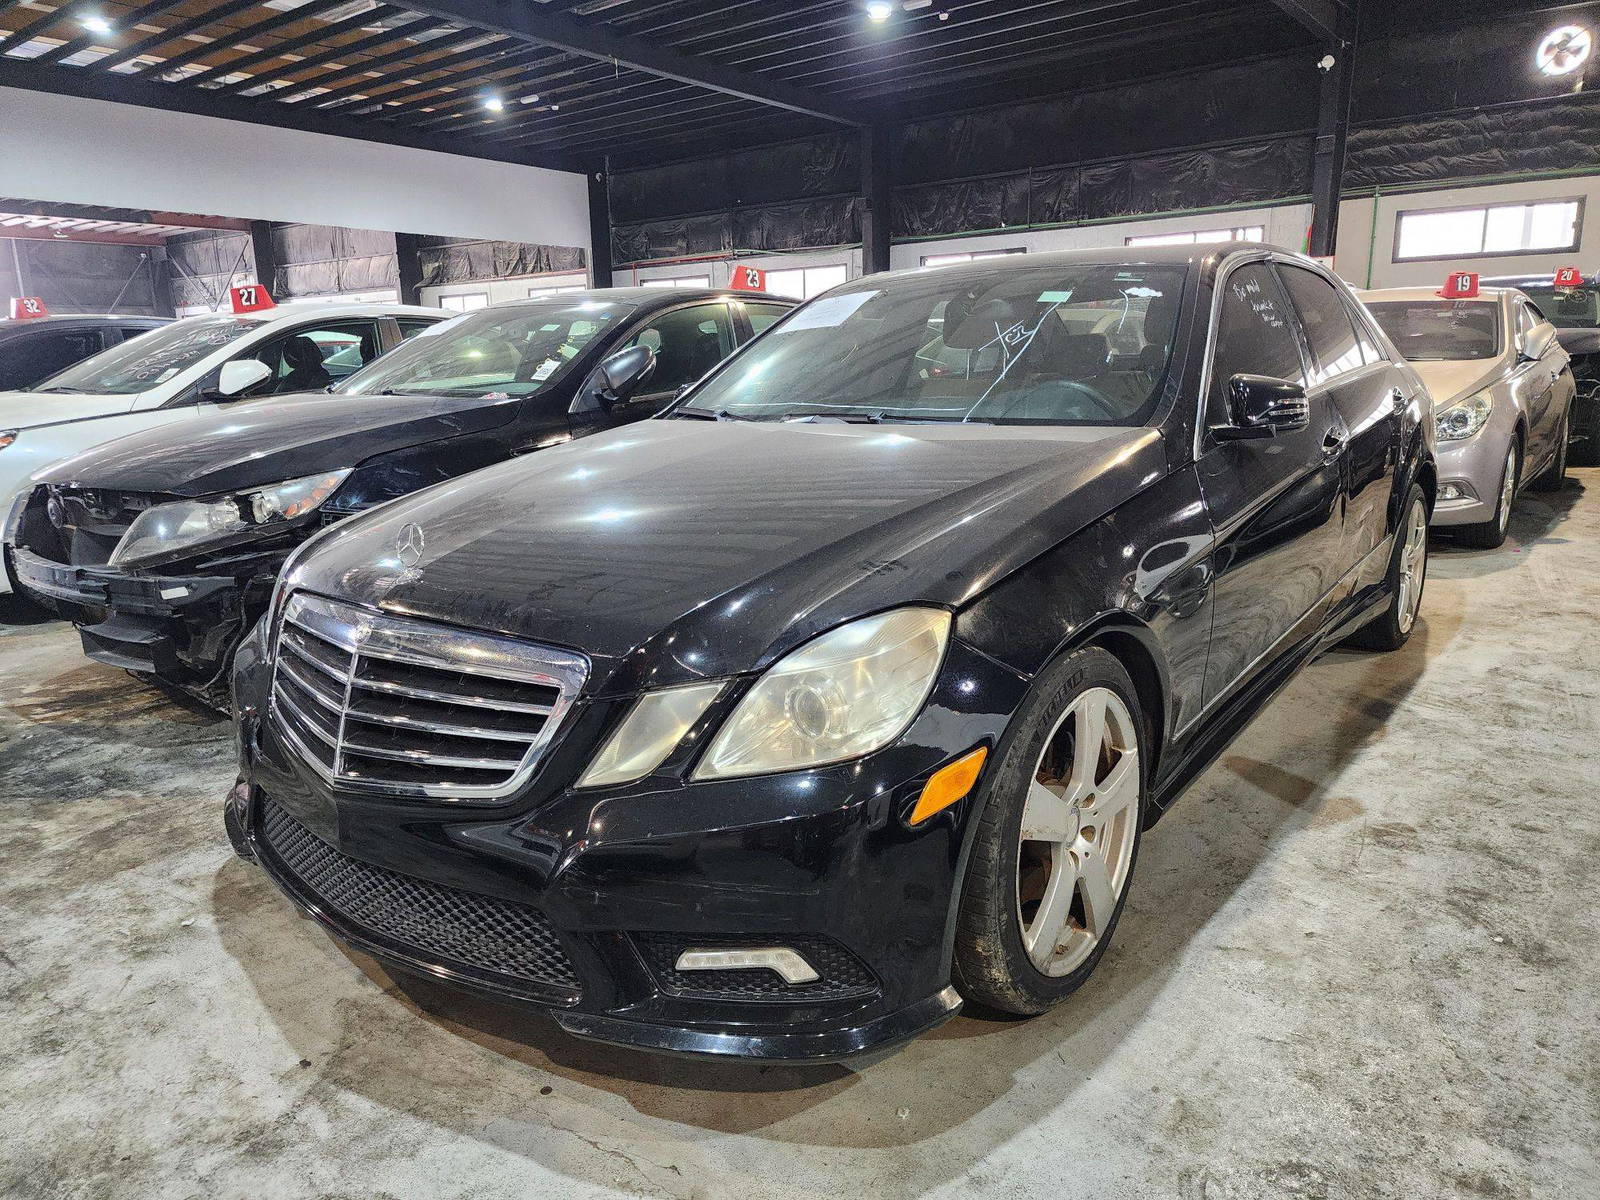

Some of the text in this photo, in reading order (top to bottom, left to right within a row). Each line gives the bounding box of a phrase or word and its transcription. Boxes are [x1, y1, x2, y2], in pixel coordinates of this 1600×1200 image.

[746, 269, 760, 288] 23
[1457, 275, 1471, 291] 19
[1561, 270, 1573, 281] 20
[240, 287, 256, 306] 27
[23, 299, 41, 314] 32
